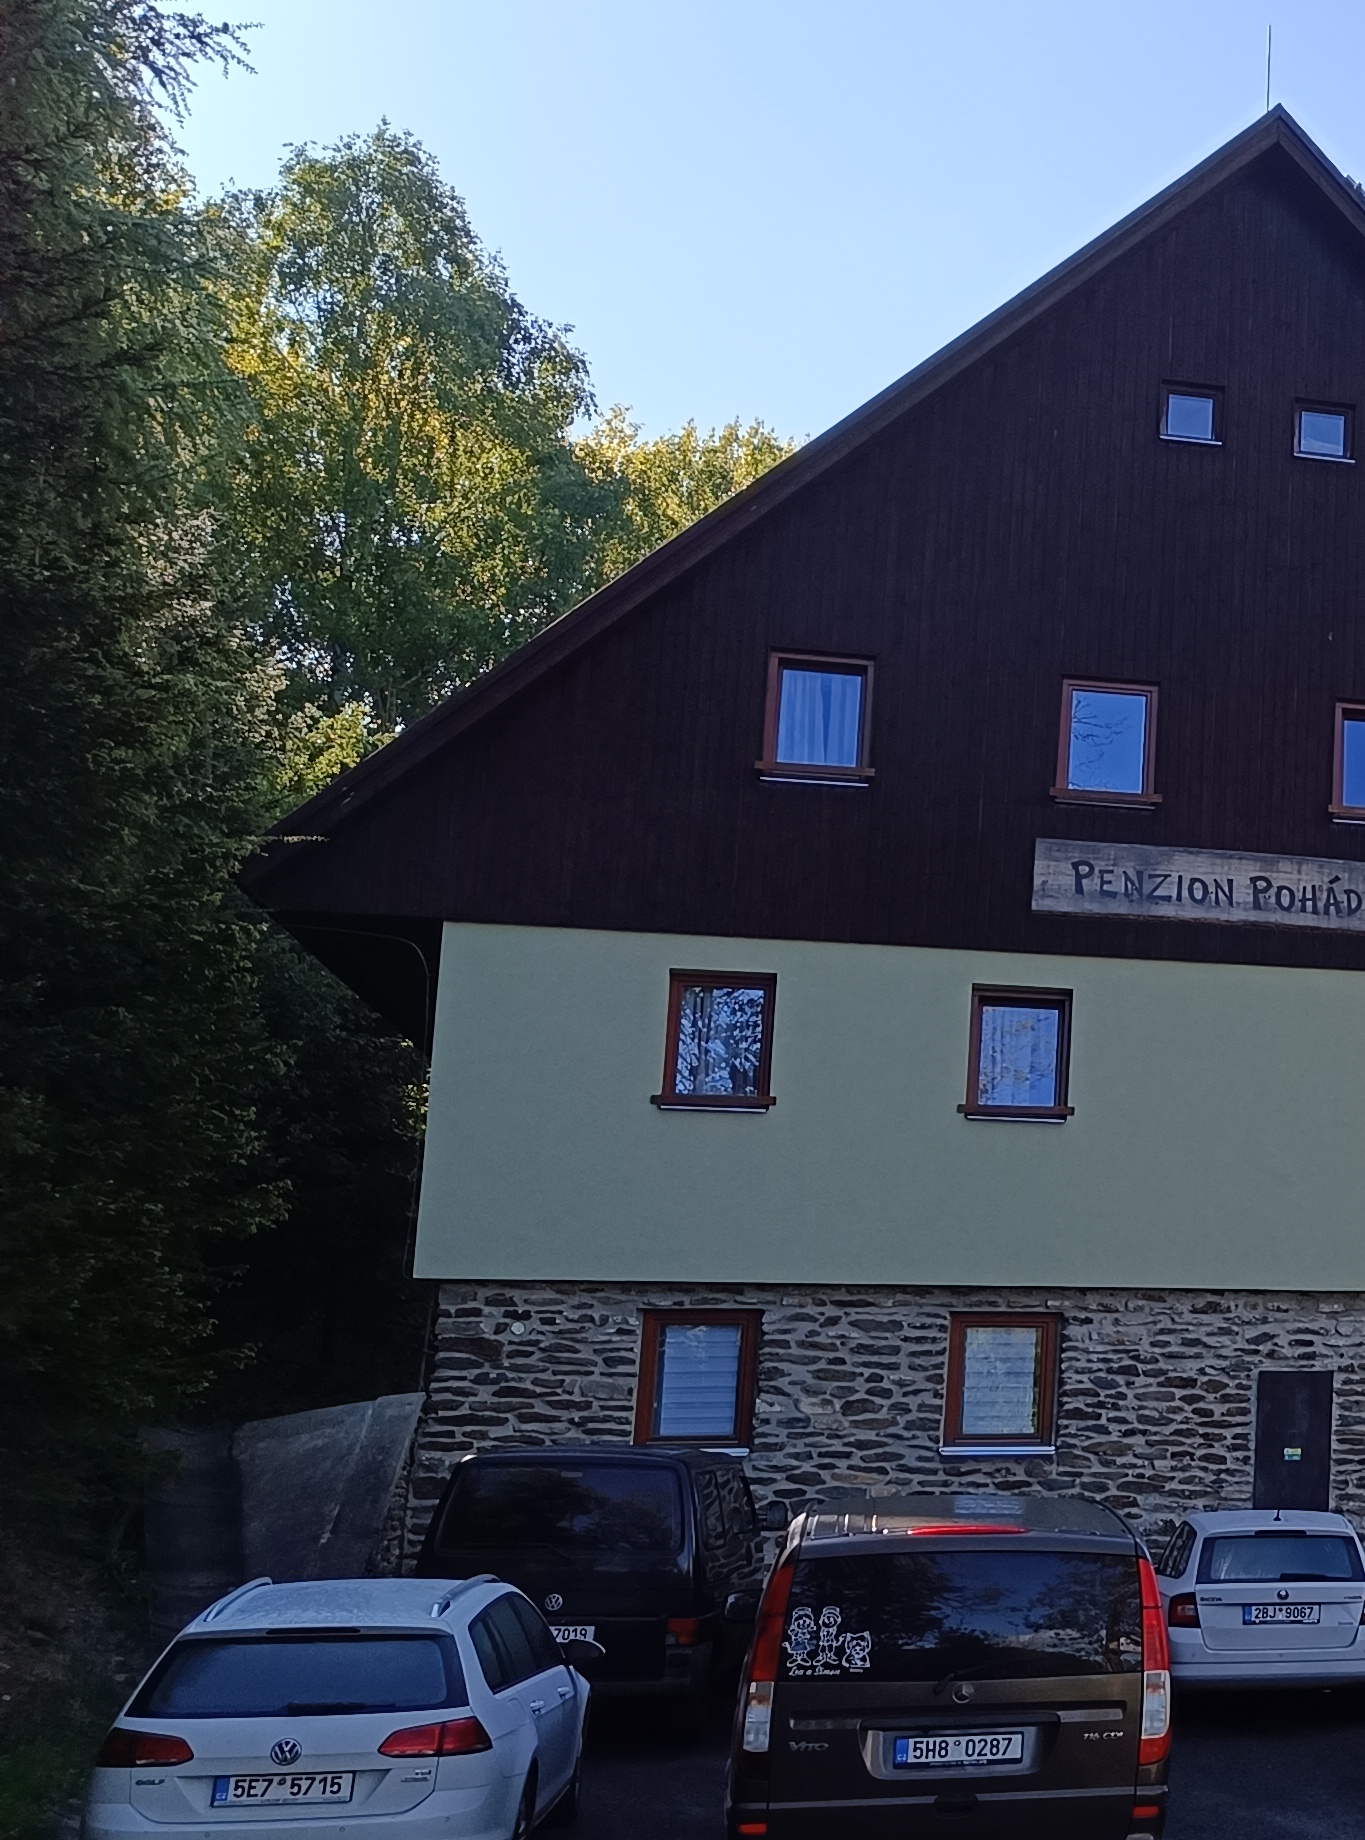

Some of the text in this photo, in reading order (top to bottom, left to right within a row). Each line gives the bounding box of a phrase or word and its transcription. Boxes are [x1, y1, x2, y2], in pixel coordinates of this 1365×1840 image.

[1071, 860, 1235, 908] PENZION
[1254, 1606, 1314, 1619] 2BJ 9067
[553, 1627, 588, 1640] 7019
[912, 1739, 949, 1759] 5H8
[965, 1738, 1013, 1757] 0287
[233, 1777, 274, 1798] 5E7
[289, 1776, 343, 1797] 5715
